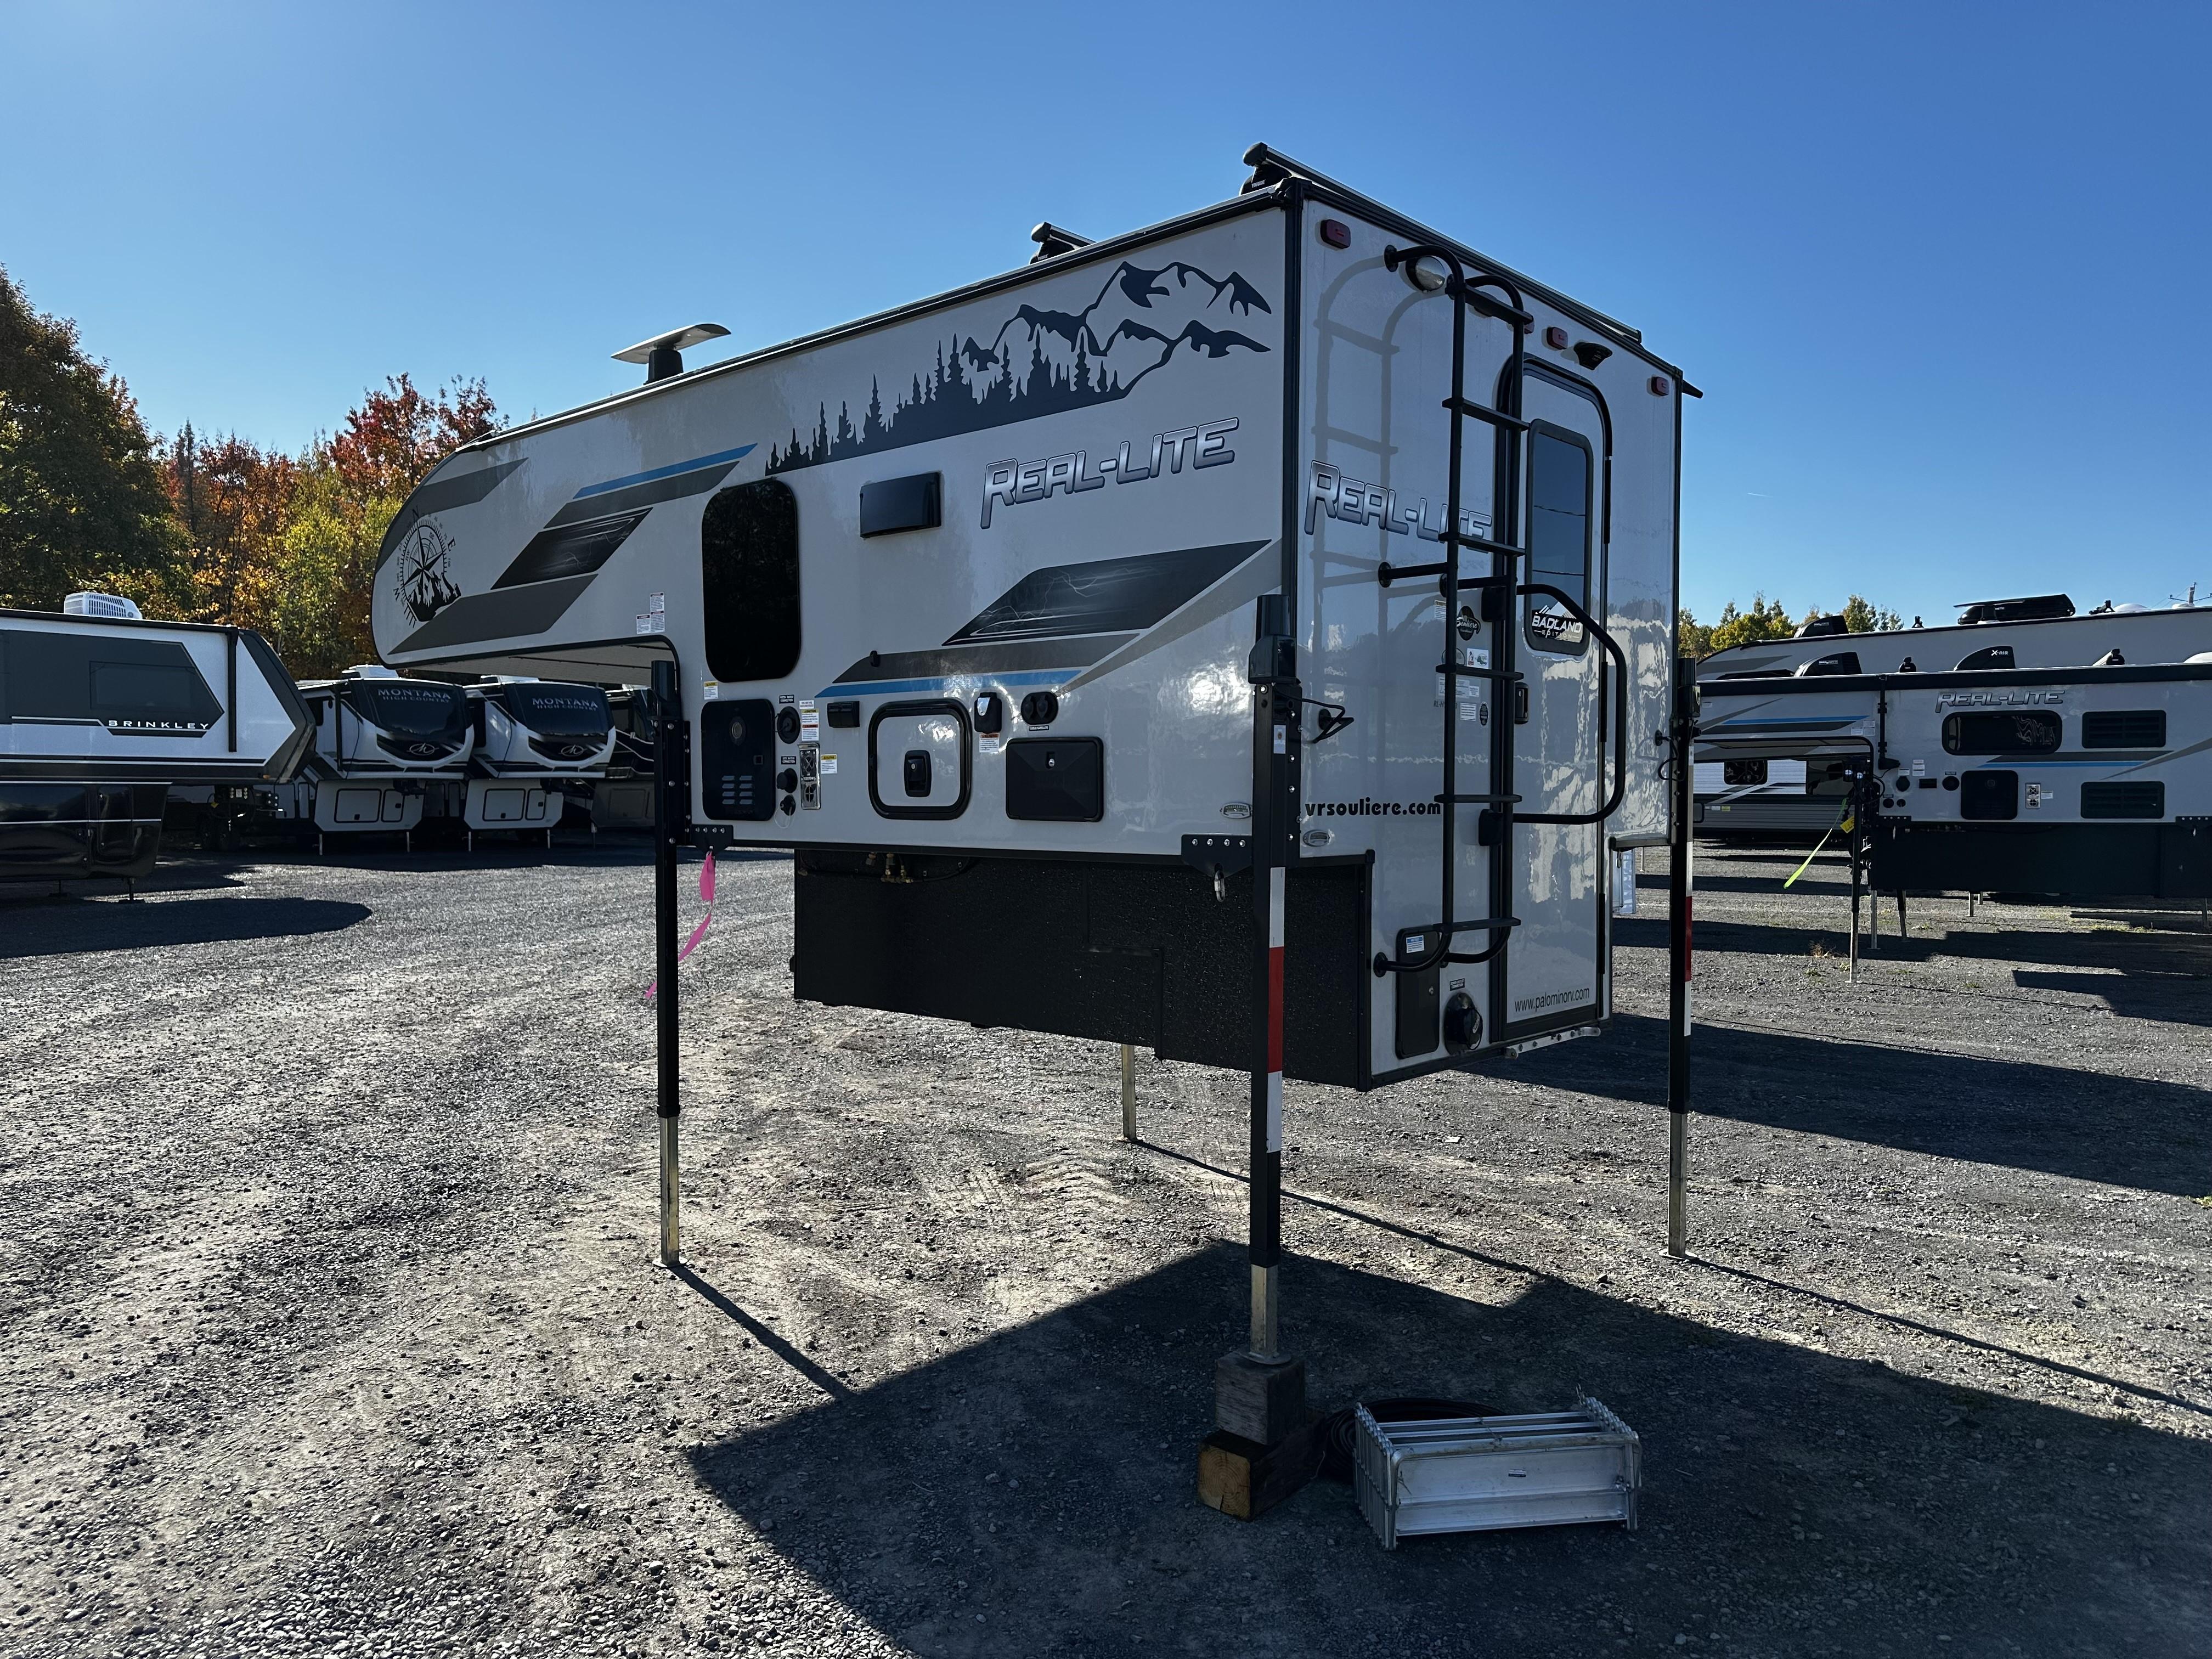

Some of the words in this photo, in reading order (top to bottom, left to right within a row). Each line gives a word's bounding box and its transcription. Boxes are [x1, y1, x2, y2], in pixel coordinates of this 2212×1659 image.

[980, 417, 1239, 529] REAL-LITE
[1531, 615, 1583, 633] BADLAND
[1542, 629, 1572, 639] EDITION
[377, 689, 451, 699] MONTANA
[532, 697, 599, 708] MONTANA
[1935, 690, 2066, 713] REAL-LITE
[108, 720, 209, 729] BRINKLEY
[1305, 797, 1441, 816] vrsouliere.com
[1514, 987, 1589, 1012] www.palominorv.com
